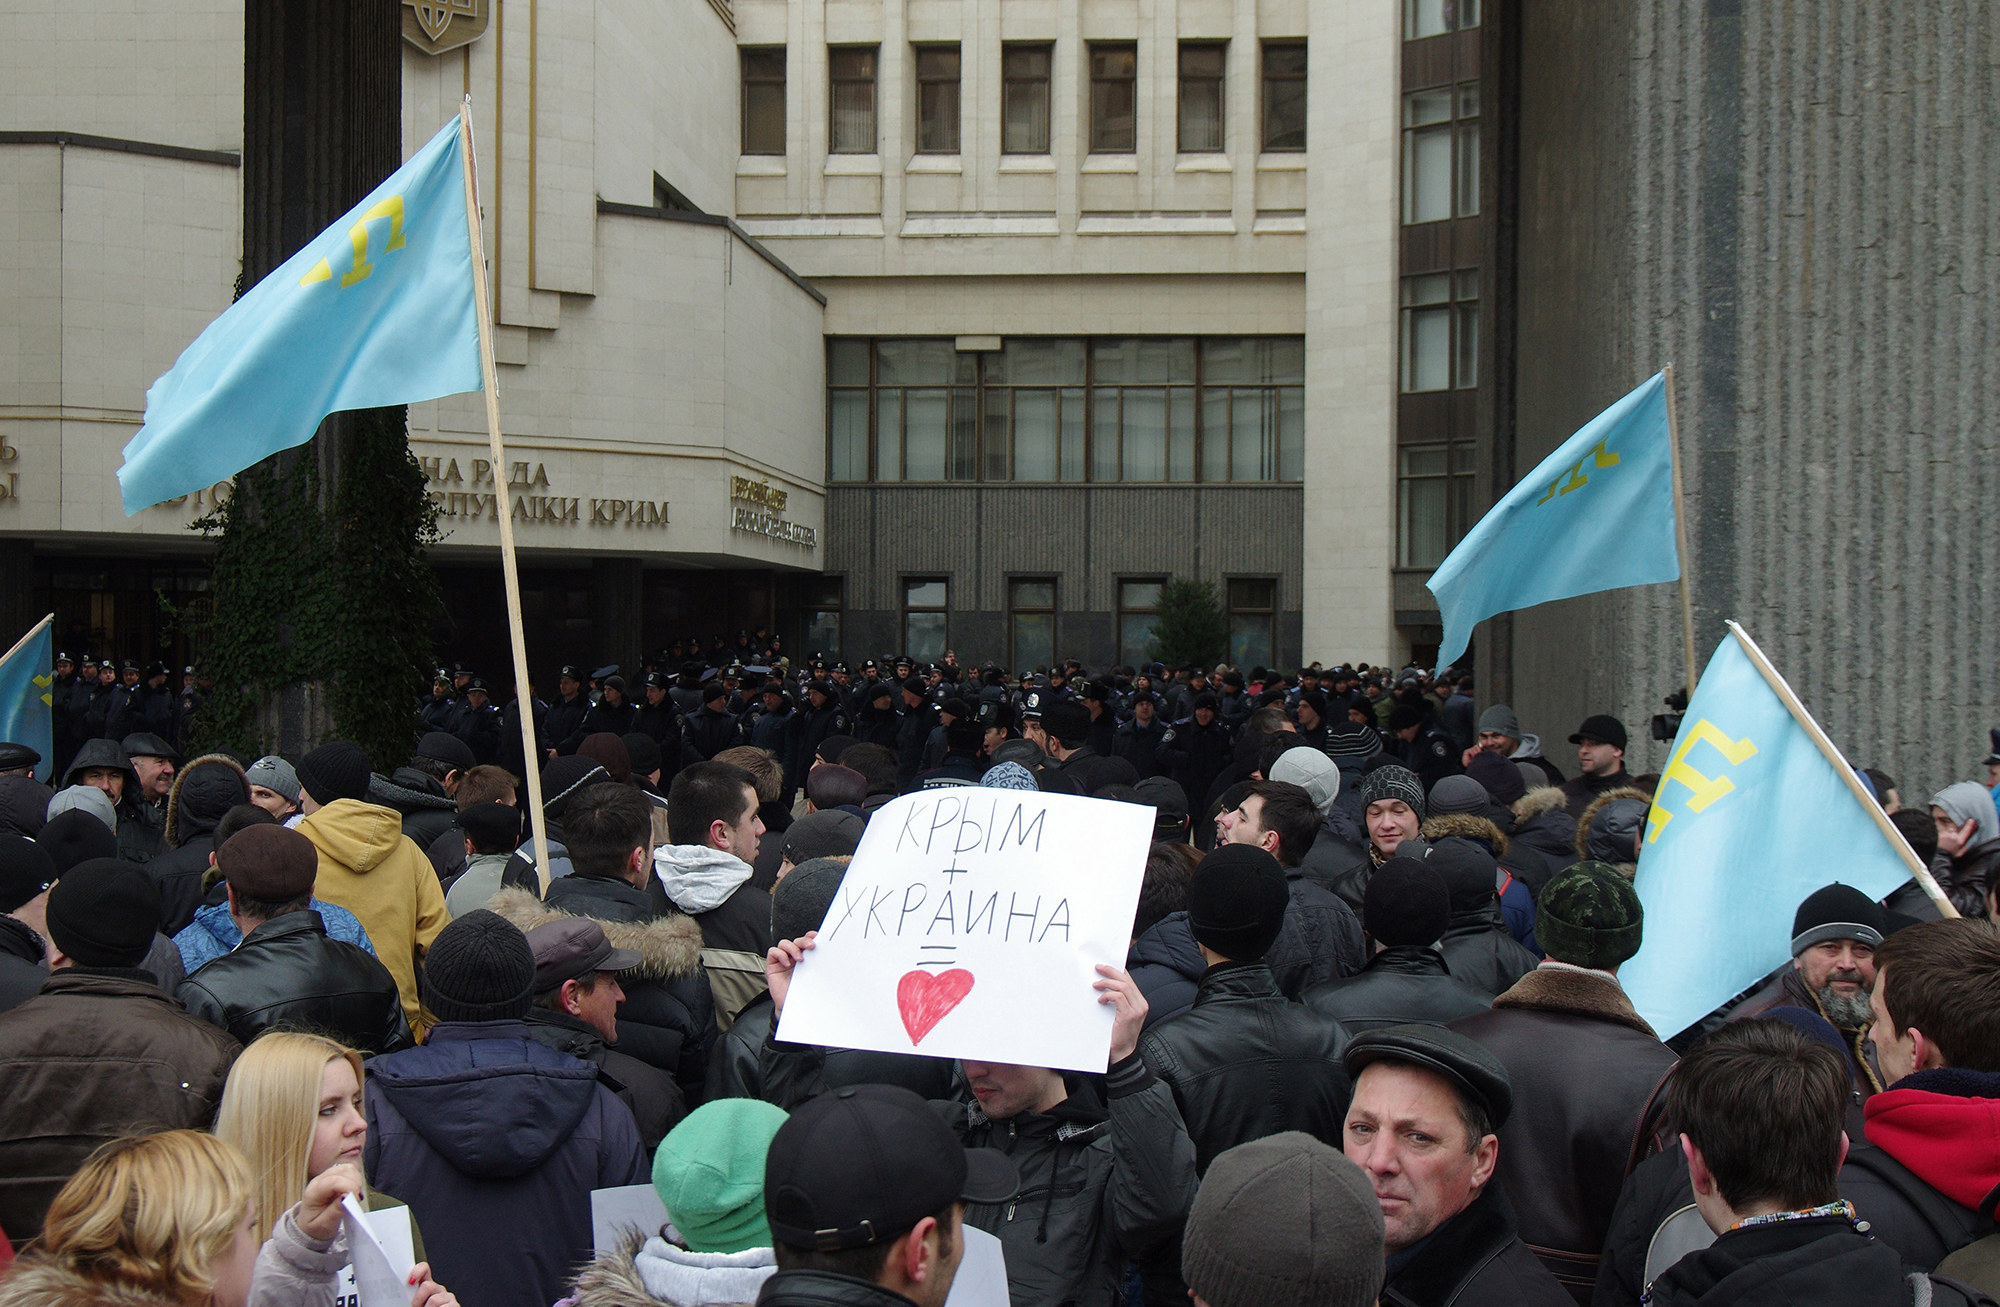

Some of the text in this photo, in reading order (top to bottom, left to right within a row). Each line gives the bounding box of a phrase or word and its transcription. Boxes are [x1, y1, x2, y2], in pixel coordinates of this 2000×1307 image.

[473, 458, 551, 489] РДА
[590, 498, 671, 525] КРИМ
[896, 796, 1046, 855] КРЫМ
[829, 883, 1071, 943] УКРАИНА
